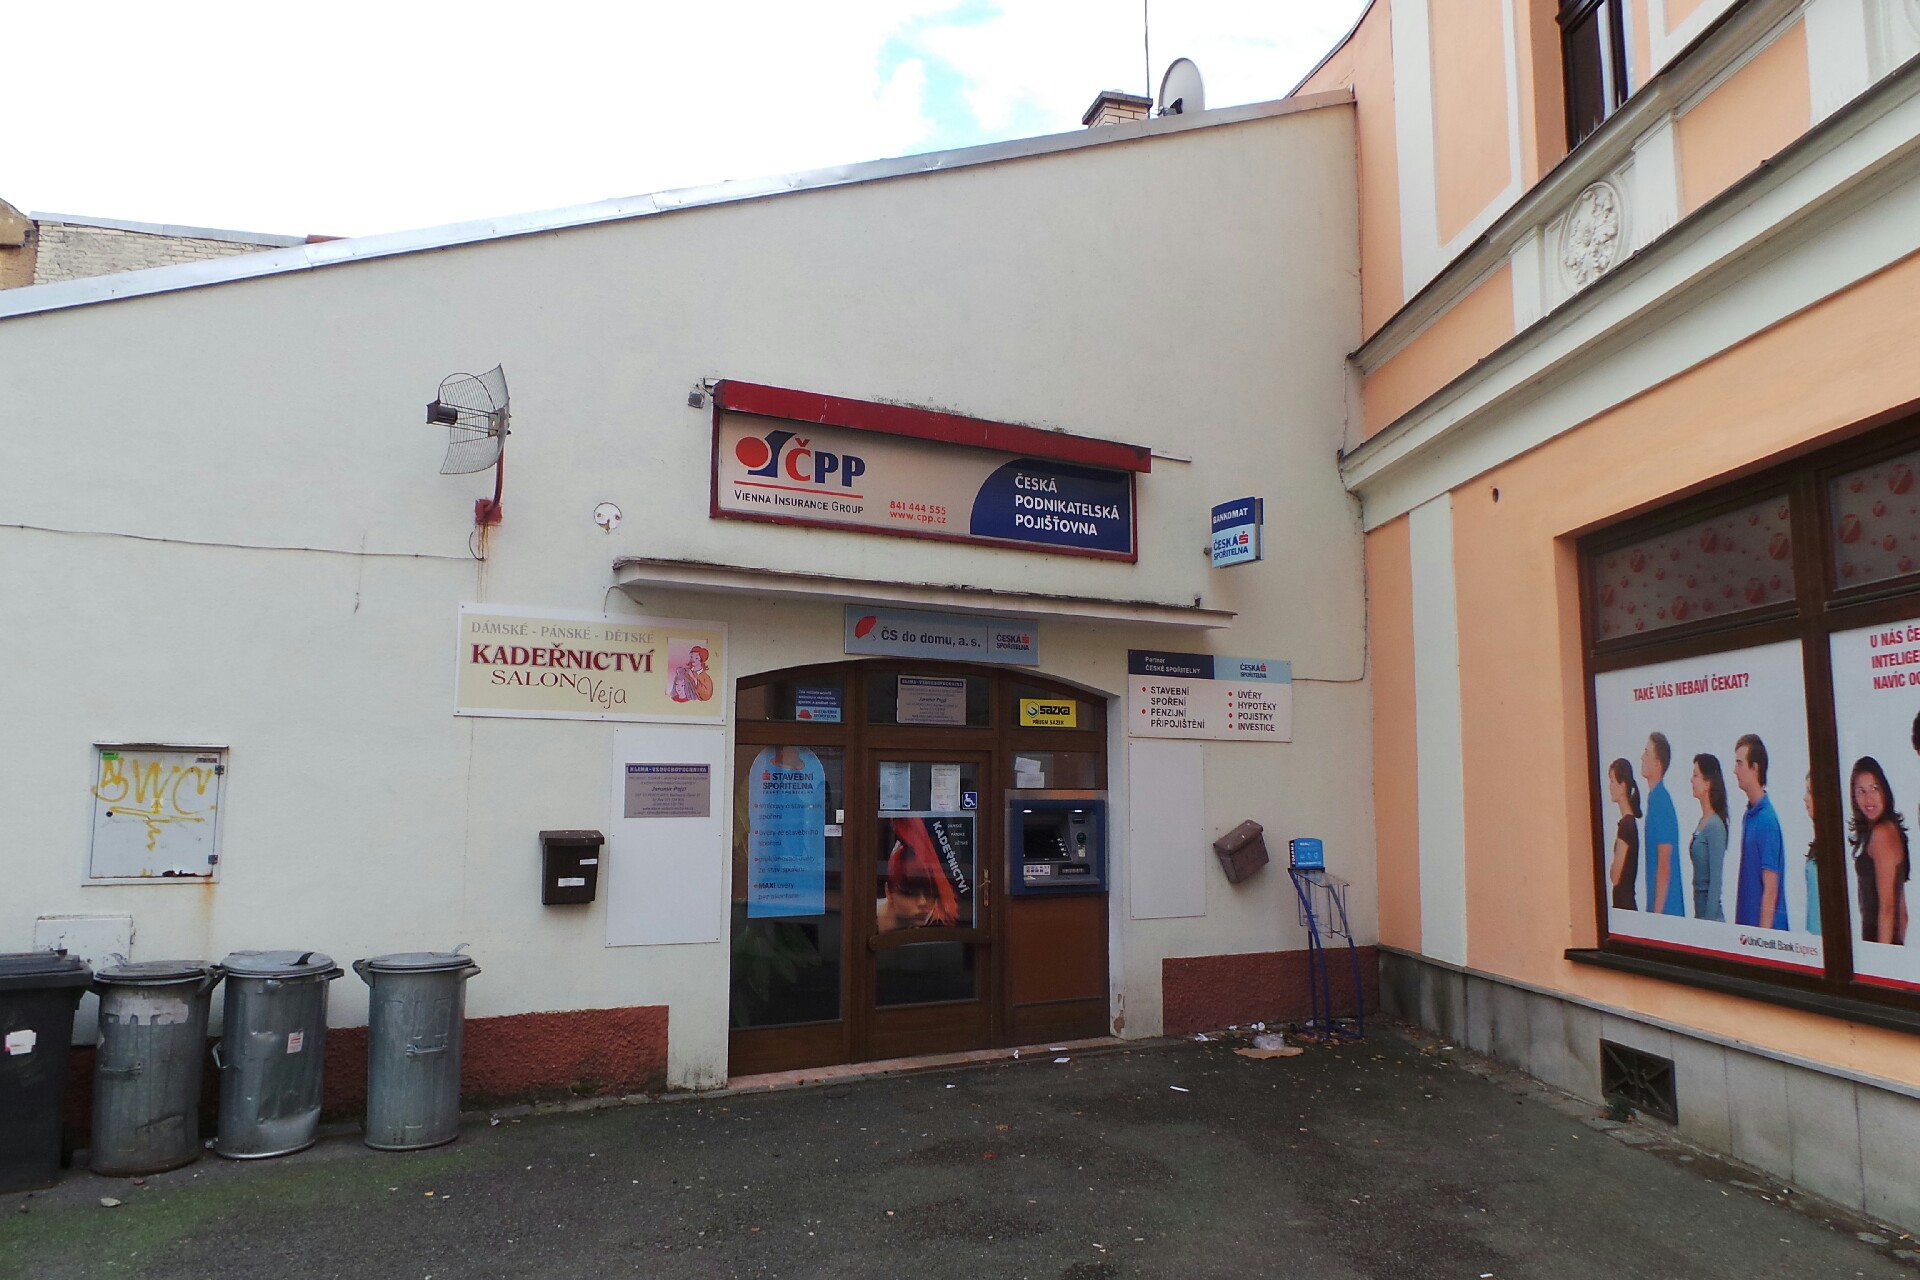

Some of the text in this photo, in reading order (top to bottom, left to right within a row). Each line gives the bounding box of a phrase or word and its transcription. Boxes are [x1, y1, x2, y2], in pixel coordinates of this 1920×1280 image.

[785, 437, 865, 487] ČPP
[1015, 473, 1057, 493] ČESKÁ
[734, 489, 863, 514] VIENNA INSURANCE GROUP
[890, 500, 946, 515] 841 444 555
[1015, 494, 1120, 520] PODNIKATELSKÁ
[890, 511, 947, 524] www.cpp.cz
[1015, 513, 1097, 535] POJIŠŤOVNA
[1213, 507, 1248, 524] BANKOMAT
[1213, 533, 1238, 551] ČESKÁ
[1213, 546, 1248, 560] SPOŘITELNA
[472, 621, 528, 636] DÁMSKÉ
[541, 625, 591, 640] PÁNSKÉ
[881, 627, 898, 641] ČS
[902, 631, 916, 642] do
[920, 632, 956, 648] domu,
[996, 633, 1022, 643] ČESKÁ
[1870, 635, 1878, 648] U
[1881, 628, 1903, 646] NÁS
[470, 642, 655, 673] KADEŘNICTVÍ
[1240, 662, 1260, 672] ČESKÁ
[1633, 673, 1749, 701] TAKÉ VÁS NEBAVÍ ČEKAT?
[1873, 670, 1905, 690] NAVÍC
[491, 670, 627, 709] SALON Veja
[1150, 686, 1190, 696] STAVEBNÍ
[1237, 689, 1262, 700] ÚVĚRY
[1150, 696, 1186, 706] SPOŘENÍ
[1237, 701, 1277, 711] HYPOTÉKY
[1150, 708, 1186, 717] PENZIJNÍ
[1238, 712, 1273, 721] POJISTKY
[1150, 719, 1205, 729] PŘIPOJIŠTĚNÍ
[1238, 723, 1275, 732] INVESTICE
[772, 771, 814, 781] STAVEBNÍ
[762, 781, 813, 790] SPOŘITELNA
[932, 820, 970, 894] KADEŘNICTVÍ
[1748, 936, 1818, 956] UniCredit Bank Expres
